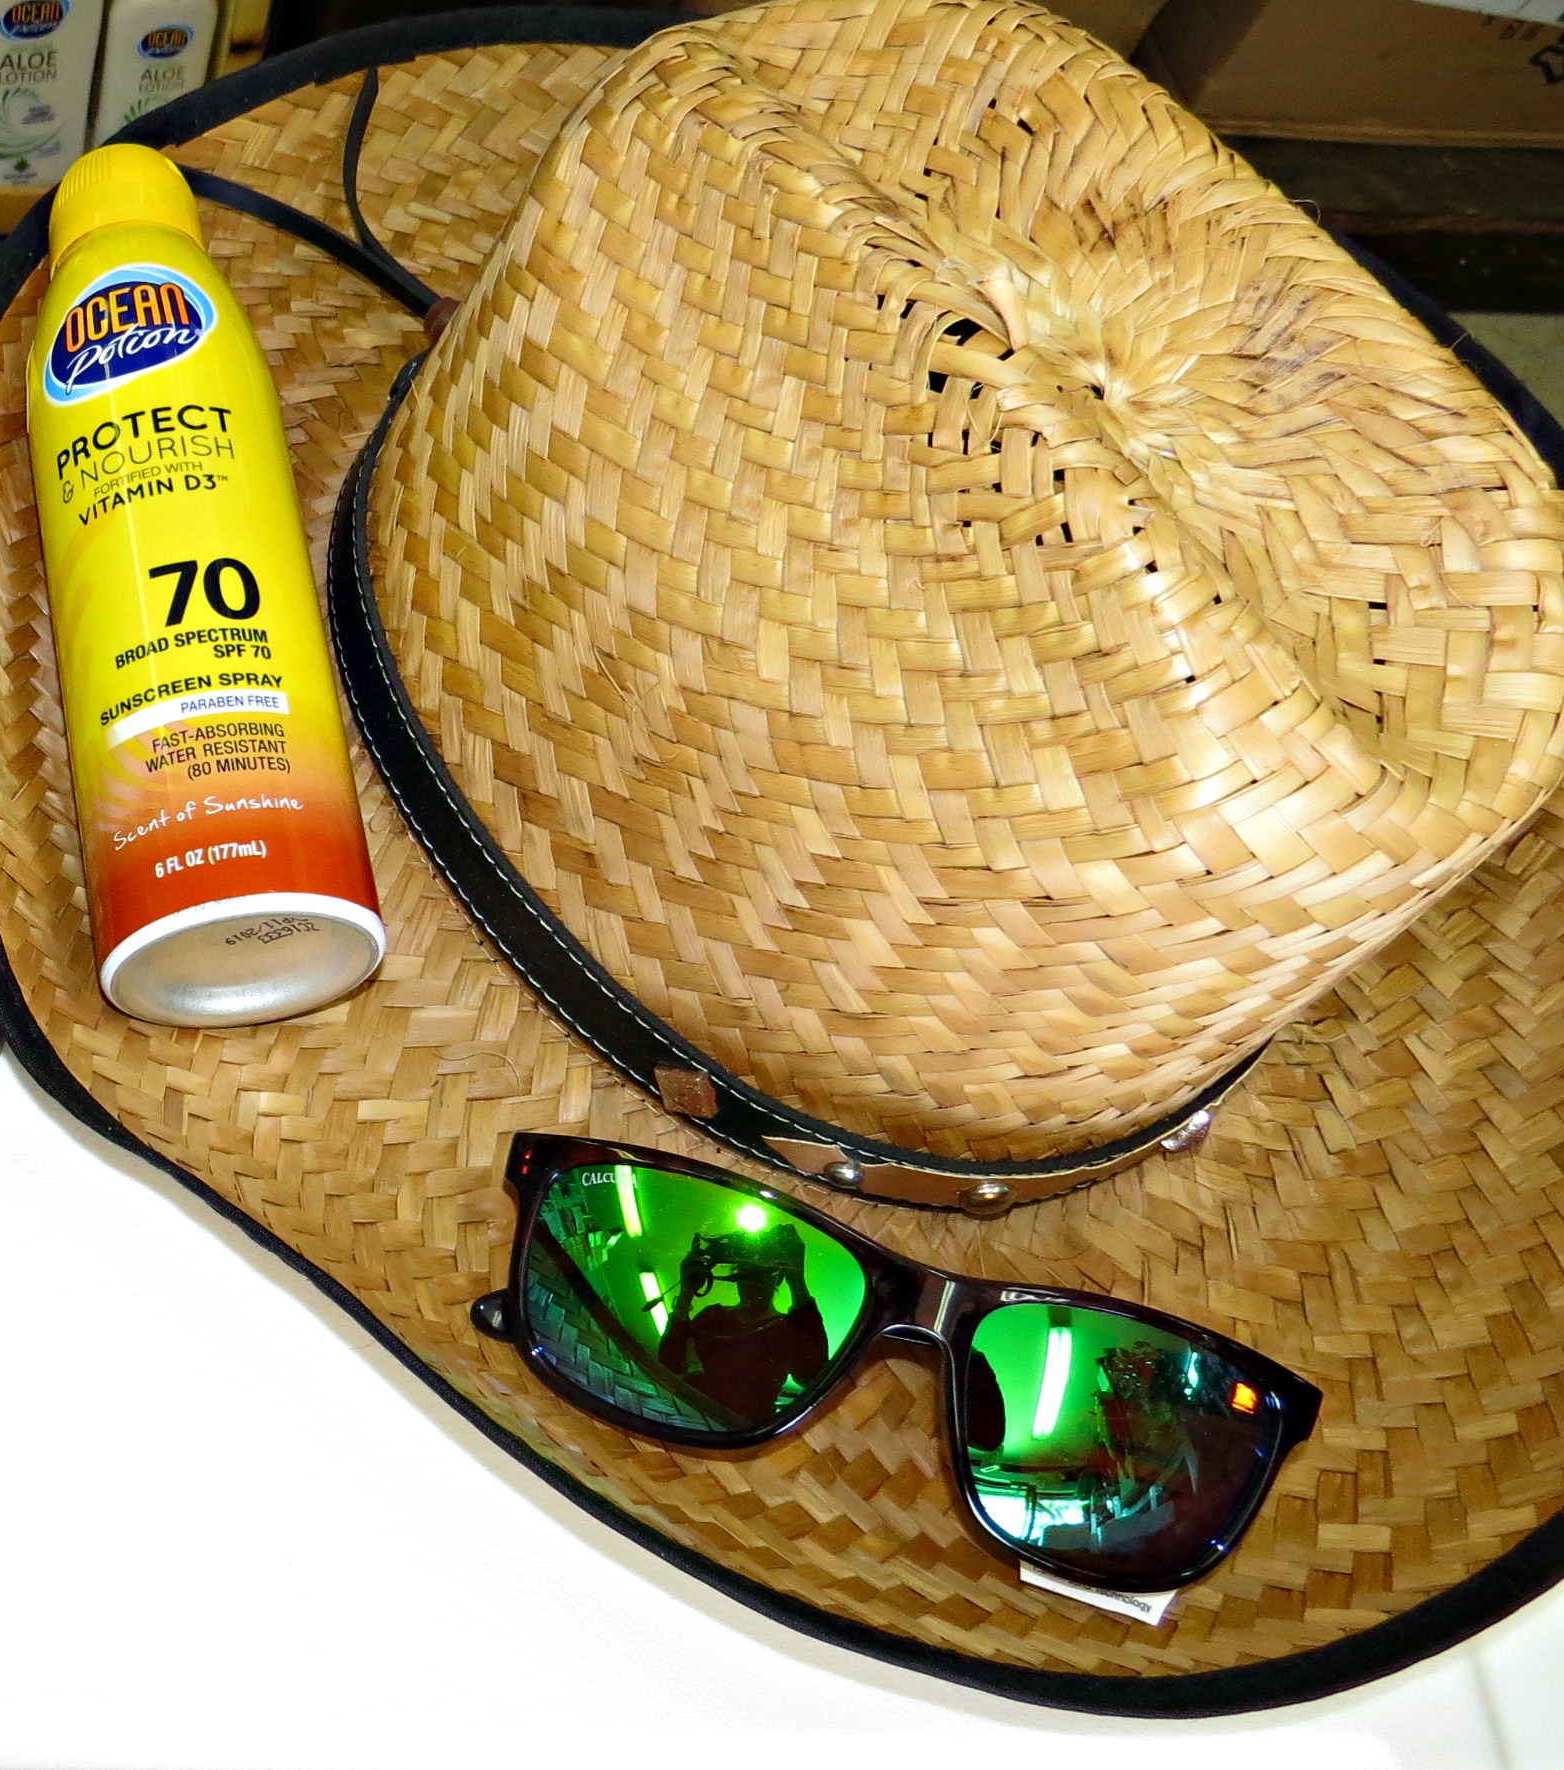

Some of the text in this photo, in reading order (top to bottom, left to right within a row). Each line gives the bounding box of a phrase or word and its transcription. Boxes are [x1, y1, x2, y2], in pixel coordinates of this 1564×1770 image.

[12, 1, 60, 24] OCEAN
[148, 30, 187, 47] OCEAN
[0, 50, 57, 71] ALOE
[141, 67, 184, 83] ALOE
[139, 80, 184, 93] LOTION
[65, 283, 190, 353] OCEAN
[57, 405, 231, 480] PROTECT
[62, 435, 235, 504] & NOURISH
[93, 461, 203, 498] FORTIFIED WITH
[78, 478, 174, 526] VITAMIN
[148, 557, 261, 627] 70
[115, 627, 269, 670] BROAD SPECTRUM
[213, 644, 272, 660] SPF 70
[100, 672, 283, 726] SUNSCREEN SPRAY
[180, 695, 280, 714] PARABEN FREE
[152, 722, 285, 754] FAST-ABSORBING
[145, 739, 286, 774] WATER RESISTANT
[187, 757, 291, 781] (80 MINUTES)
[113, 793, 304, 851] Scent of Sunshine
[154, 840, 267, 879] 6 FL OZ (177mL)
[582, 1172, 639, 1189] CALCUA
[1094, 1587, 1153, 1613] chnology
